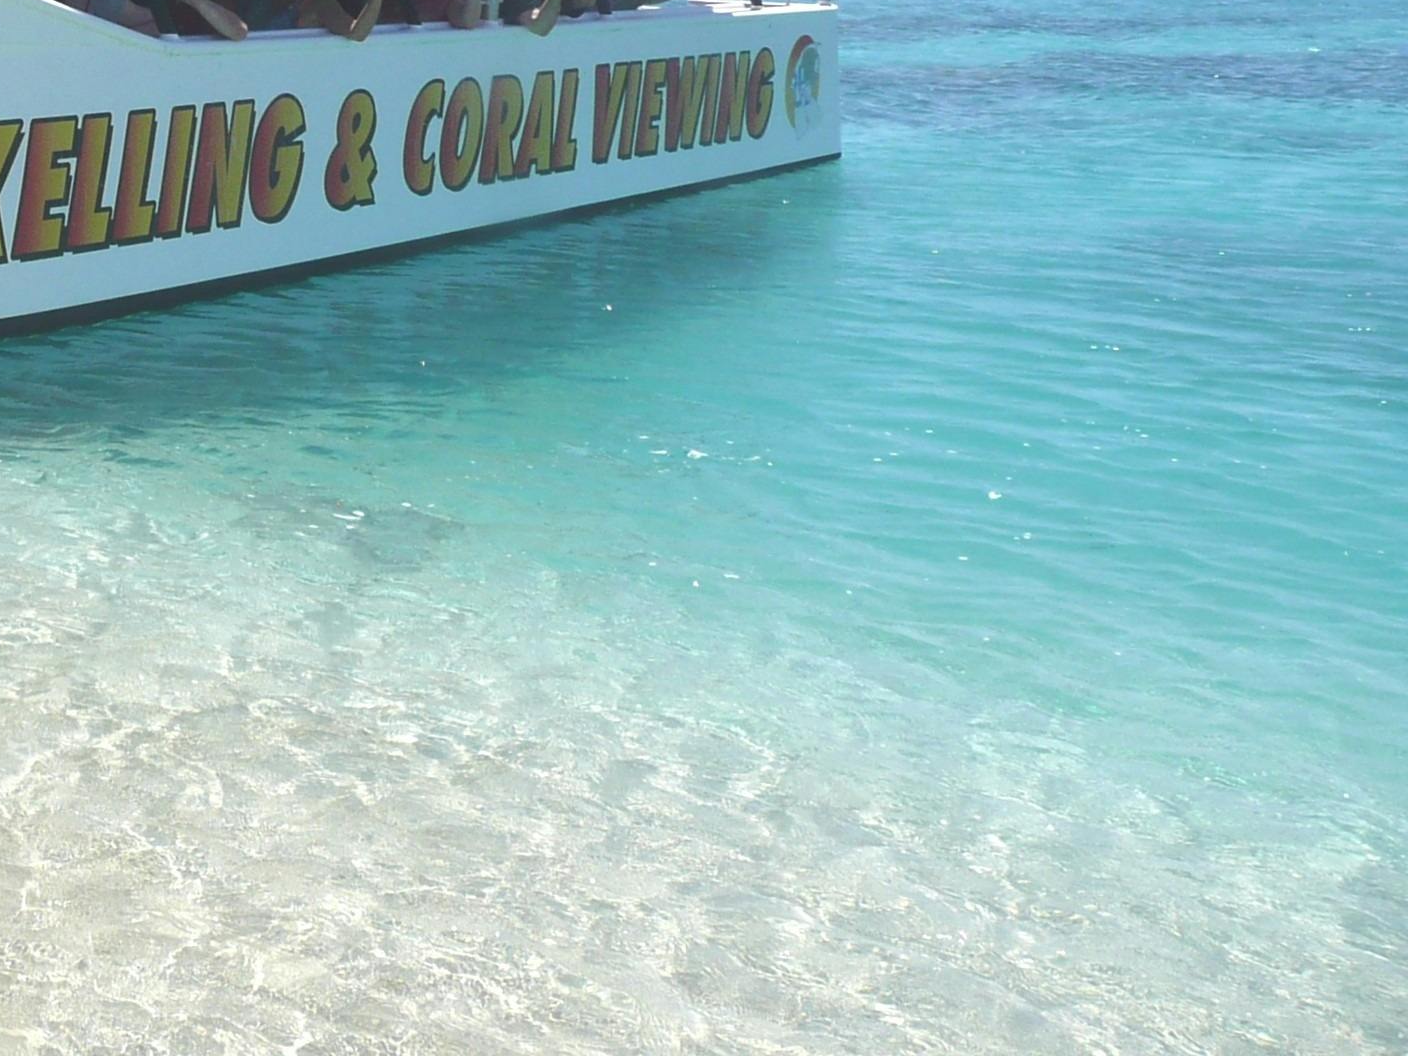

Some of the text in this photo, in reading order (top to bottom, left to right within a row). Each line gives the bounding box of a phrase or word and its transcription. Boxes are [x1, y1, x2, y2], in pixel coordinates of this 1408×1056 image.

[324, 88, 377, 211] &
[403, 68, 579, 195] CORAL
[592, 46, 775, 164] VIEWING
